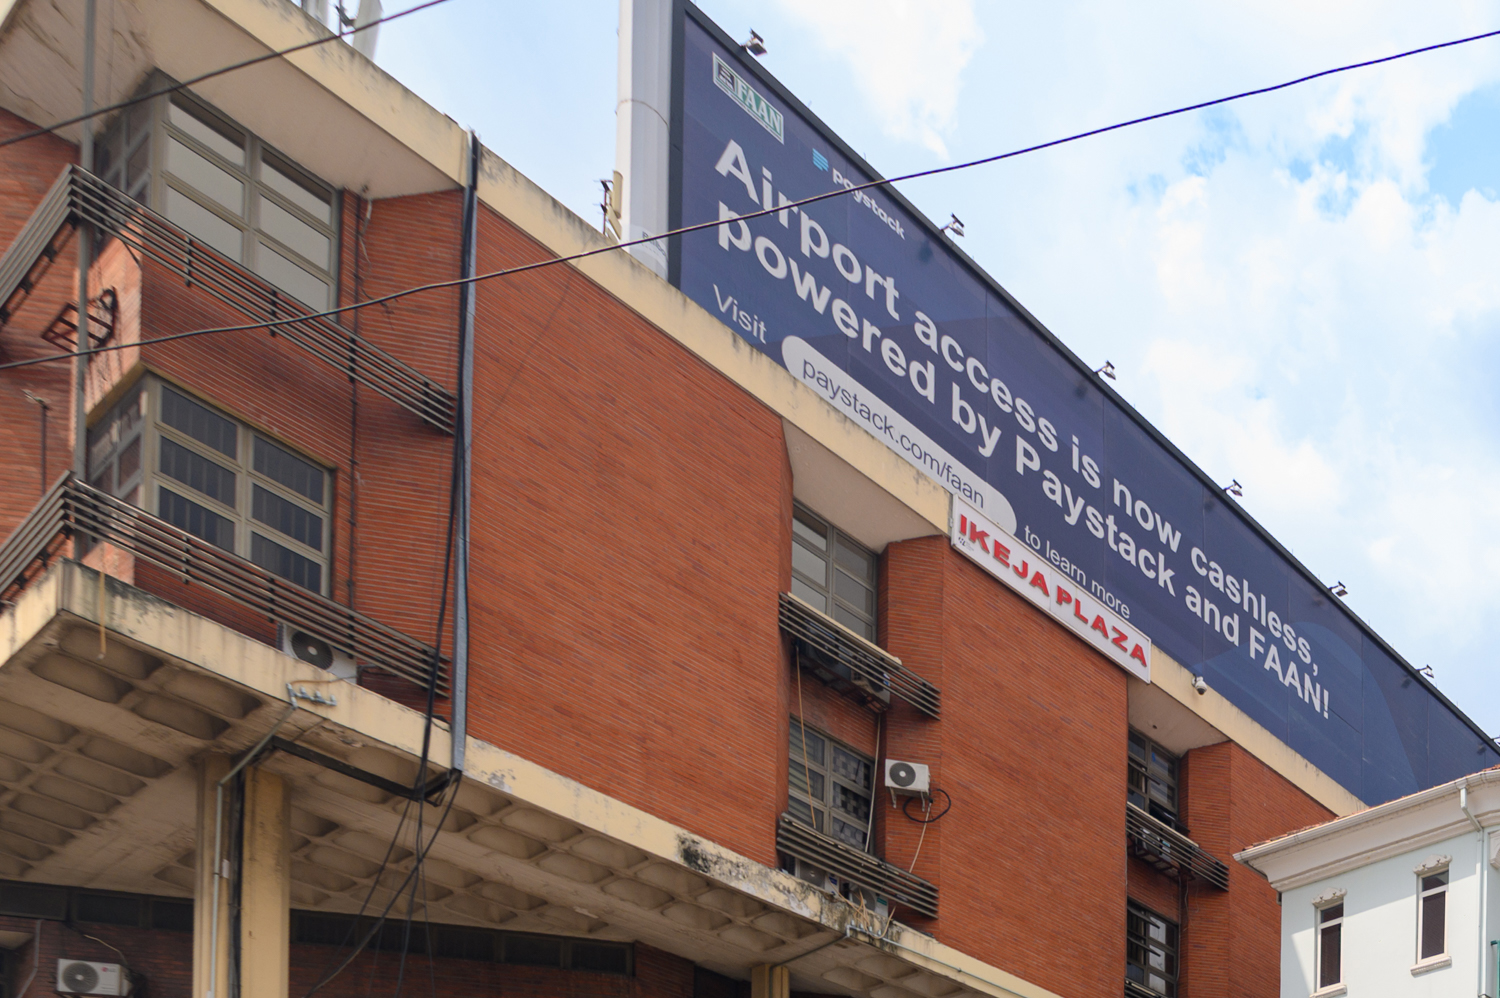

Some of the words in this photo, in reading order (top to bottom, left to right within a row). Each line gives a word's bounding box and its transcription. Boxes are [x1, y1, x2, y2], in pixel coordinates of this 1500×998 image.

[737, 79, 782, 134] FAAN
[832, 167, 905, 240] paystack
[713, 283, 767, 344] Visit
[803, 358, 985, 508] paystack.com/faan
[1024, 525, 1041, 550] to
[1046, 540, 1087, 586] learn
[1091, 579, 1131, 619] more
[715, 139, 900, 322] Airport
[914, 311, 1058, 452] access
[1072, 434, 1101, 489] is
[1113, 478, 1182, 553] now
[1190, 546, 1318, 677] cashless,
[718, 200, 936, 405] powered
[952, 381, 1002, 458] by
[1016, 434, 1176, 597] Paystack
[1185, 585, 1240, 647] and
[1250, 625, 1329, 719] FAAN!
[959, 513, 1050, 597] IKEJA
[1056, 585, 1147, 667] PLAZA
